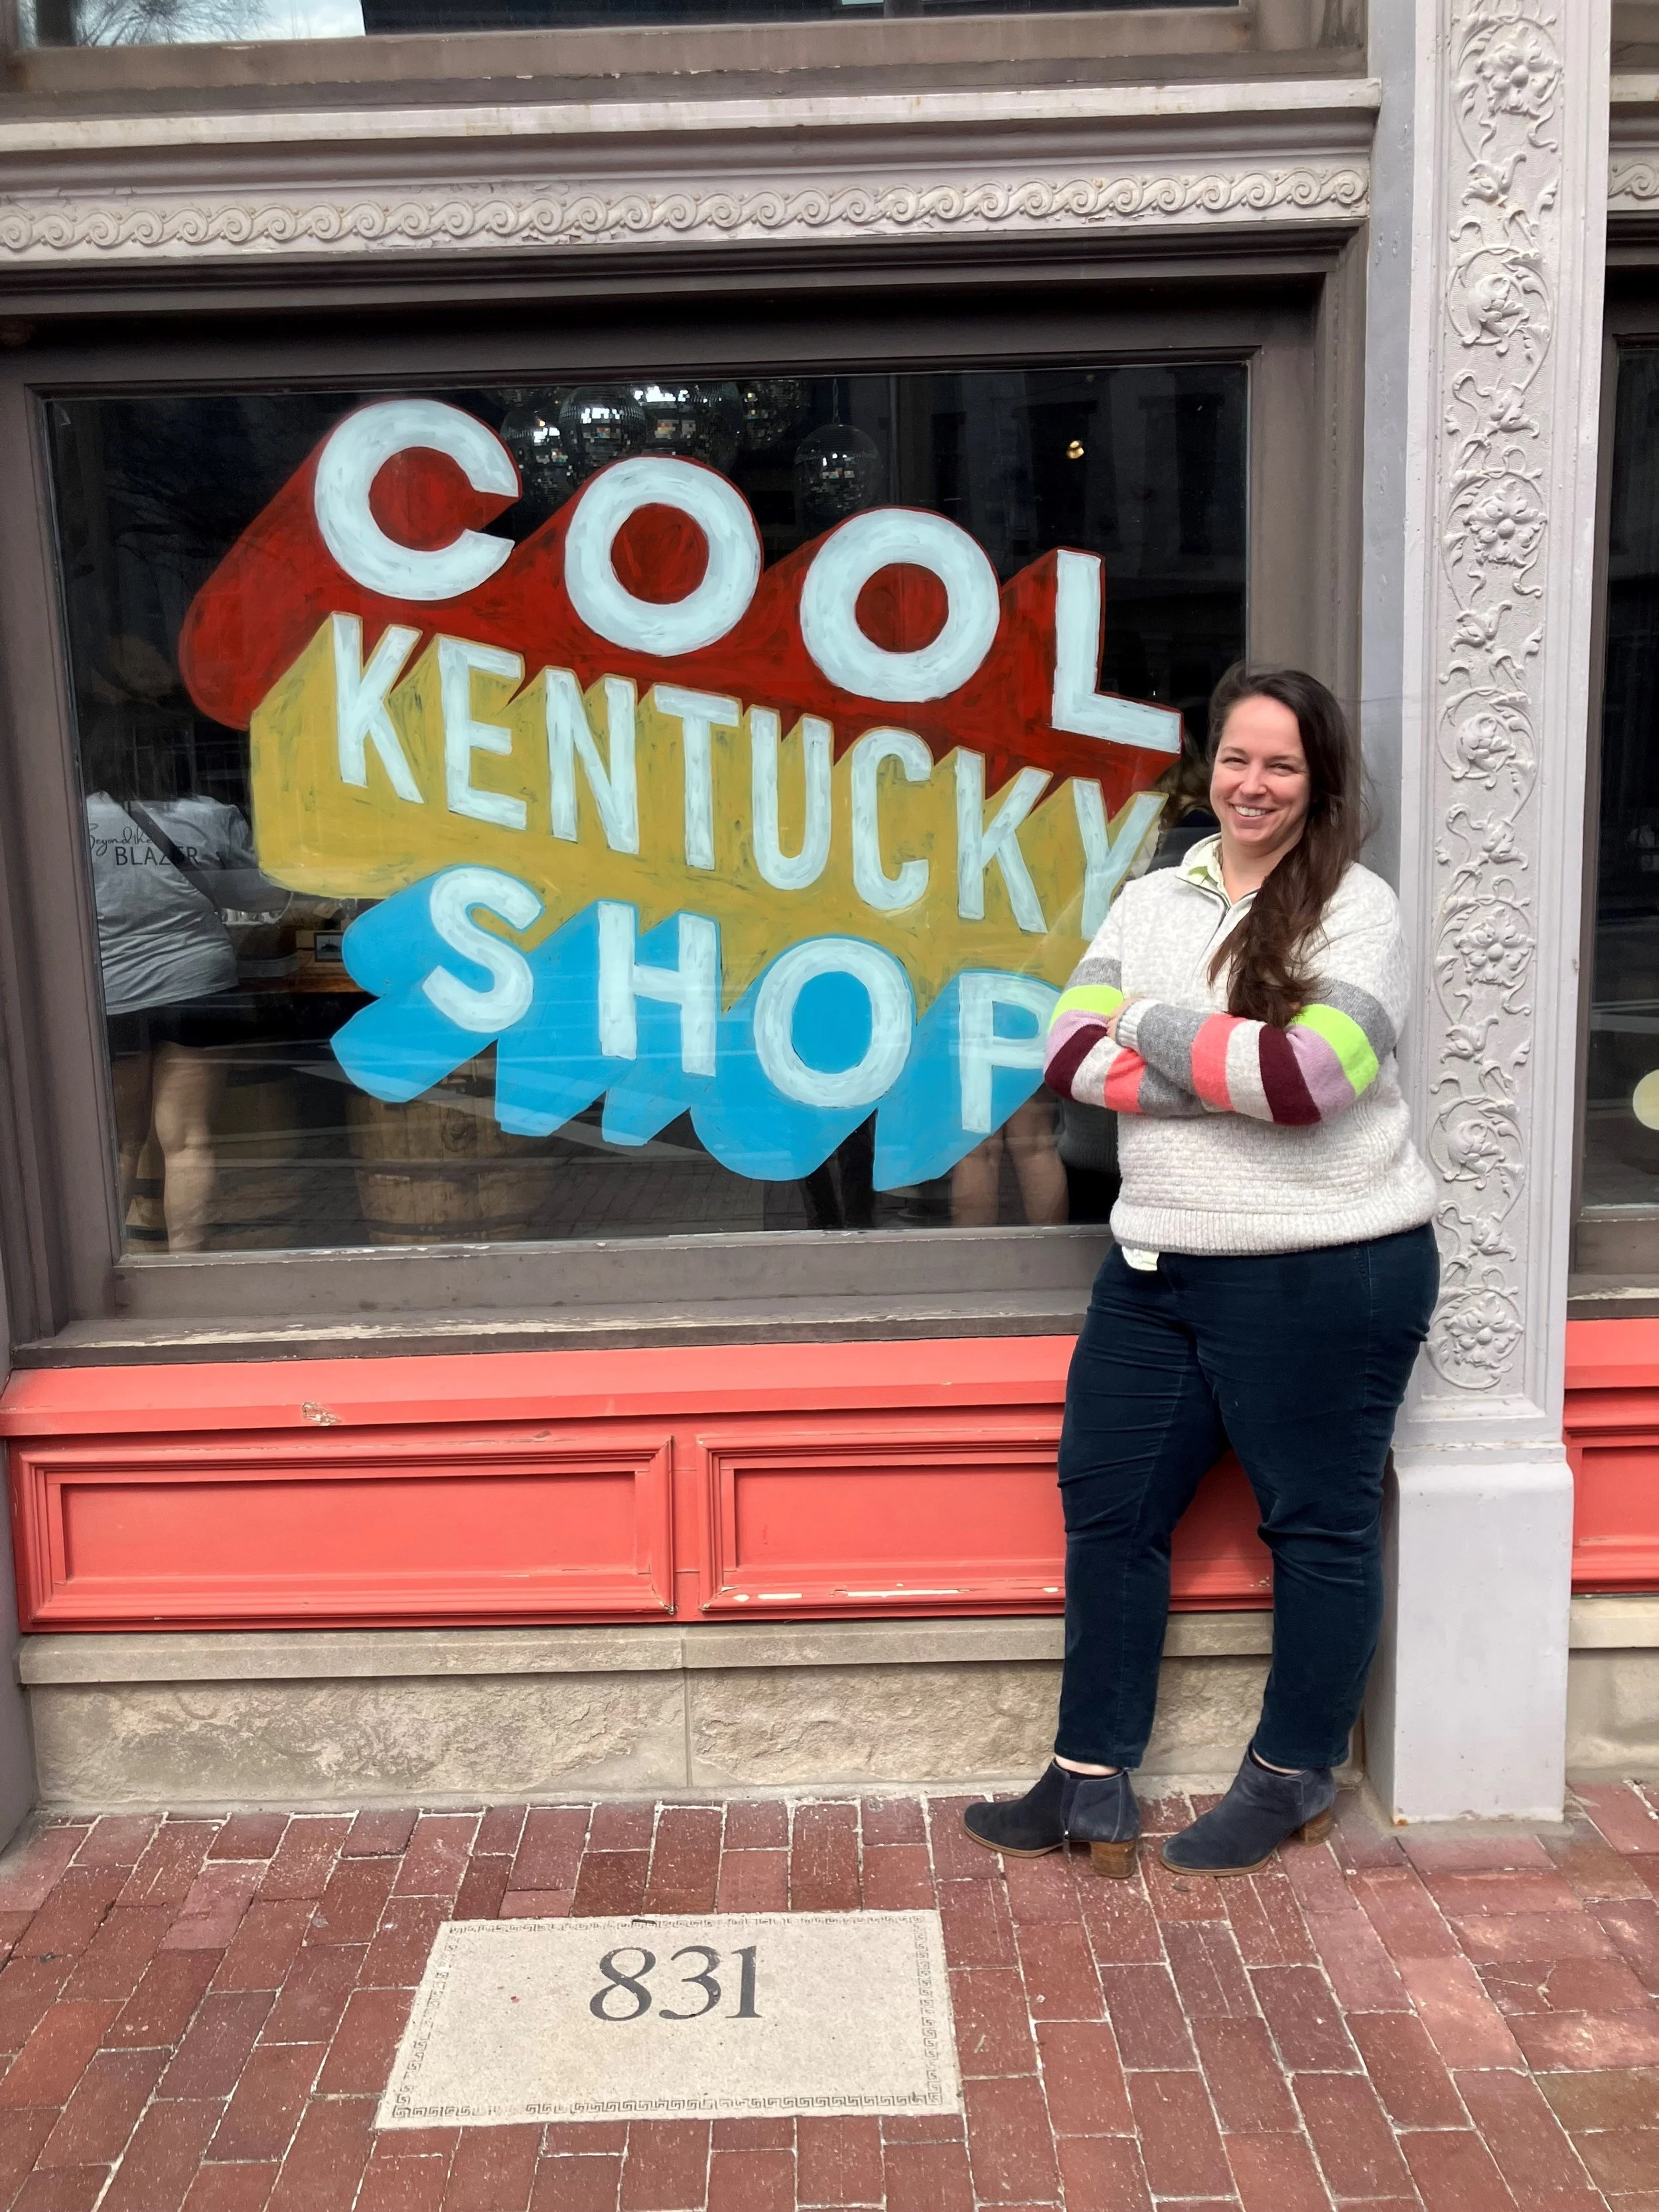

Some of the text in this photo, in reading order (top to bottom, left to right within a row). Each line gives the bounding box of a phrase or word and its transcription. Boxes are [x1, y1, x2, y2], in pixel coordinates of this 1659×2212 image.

[314, 399, 1181, 754] COOL
[115, 846, 200, 865] BLAR
[332, 611, 1163, 941] KENTUCKY
[422, 865, 1061, 1133] SHOP
[589, 1945, 762, 2022] 831
